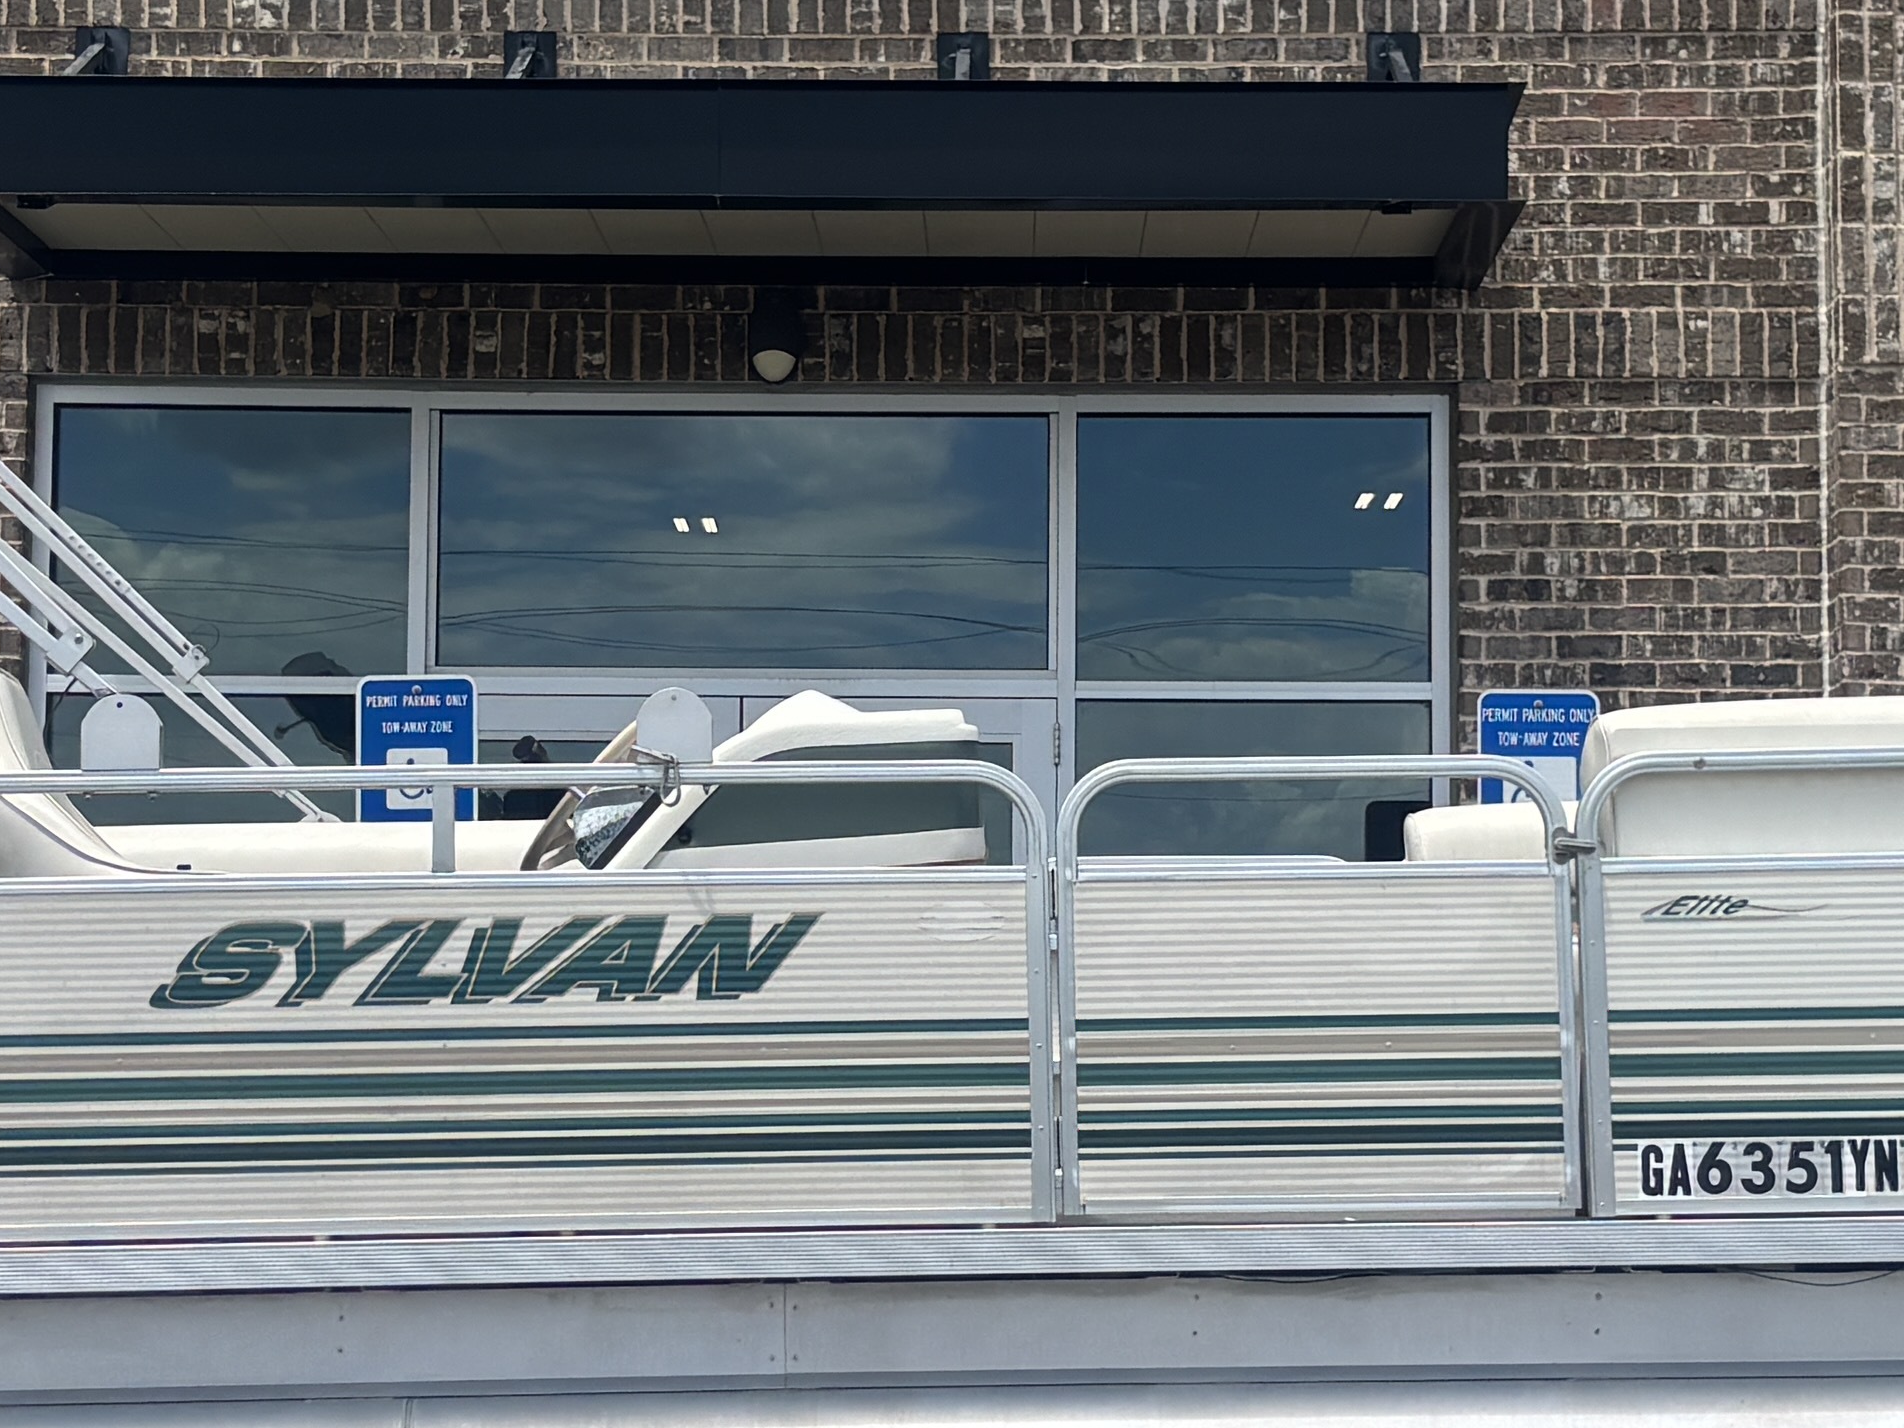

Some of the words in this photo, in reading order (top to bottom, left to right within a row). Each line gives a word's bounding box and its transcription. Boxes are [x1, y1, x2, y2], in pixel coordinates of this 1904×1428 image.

[366, 695, 397, 708] PERMIT
[402, 694, 441, 707] PARKING
[445, 694, 468, 707] ONLY
[1482, 708, 1518, 723] PERMIT
[1522, 708, 1566, 723] PARKING
[1569, 708, 1594, 723] ONLY
[382, 721, 428, 734] TOW-AWAY
[430, 720, 454, 733] ZONE
[1497, 731, 1549, 747] TOW-AWAY
[1552, 731, 1580, 747] ZONE
[1661, 894, 1749, 916] Elite
[150, 911, 825, 1010] SYLVAN
[1641, 1139, 1900, 1196] GA6351YN
